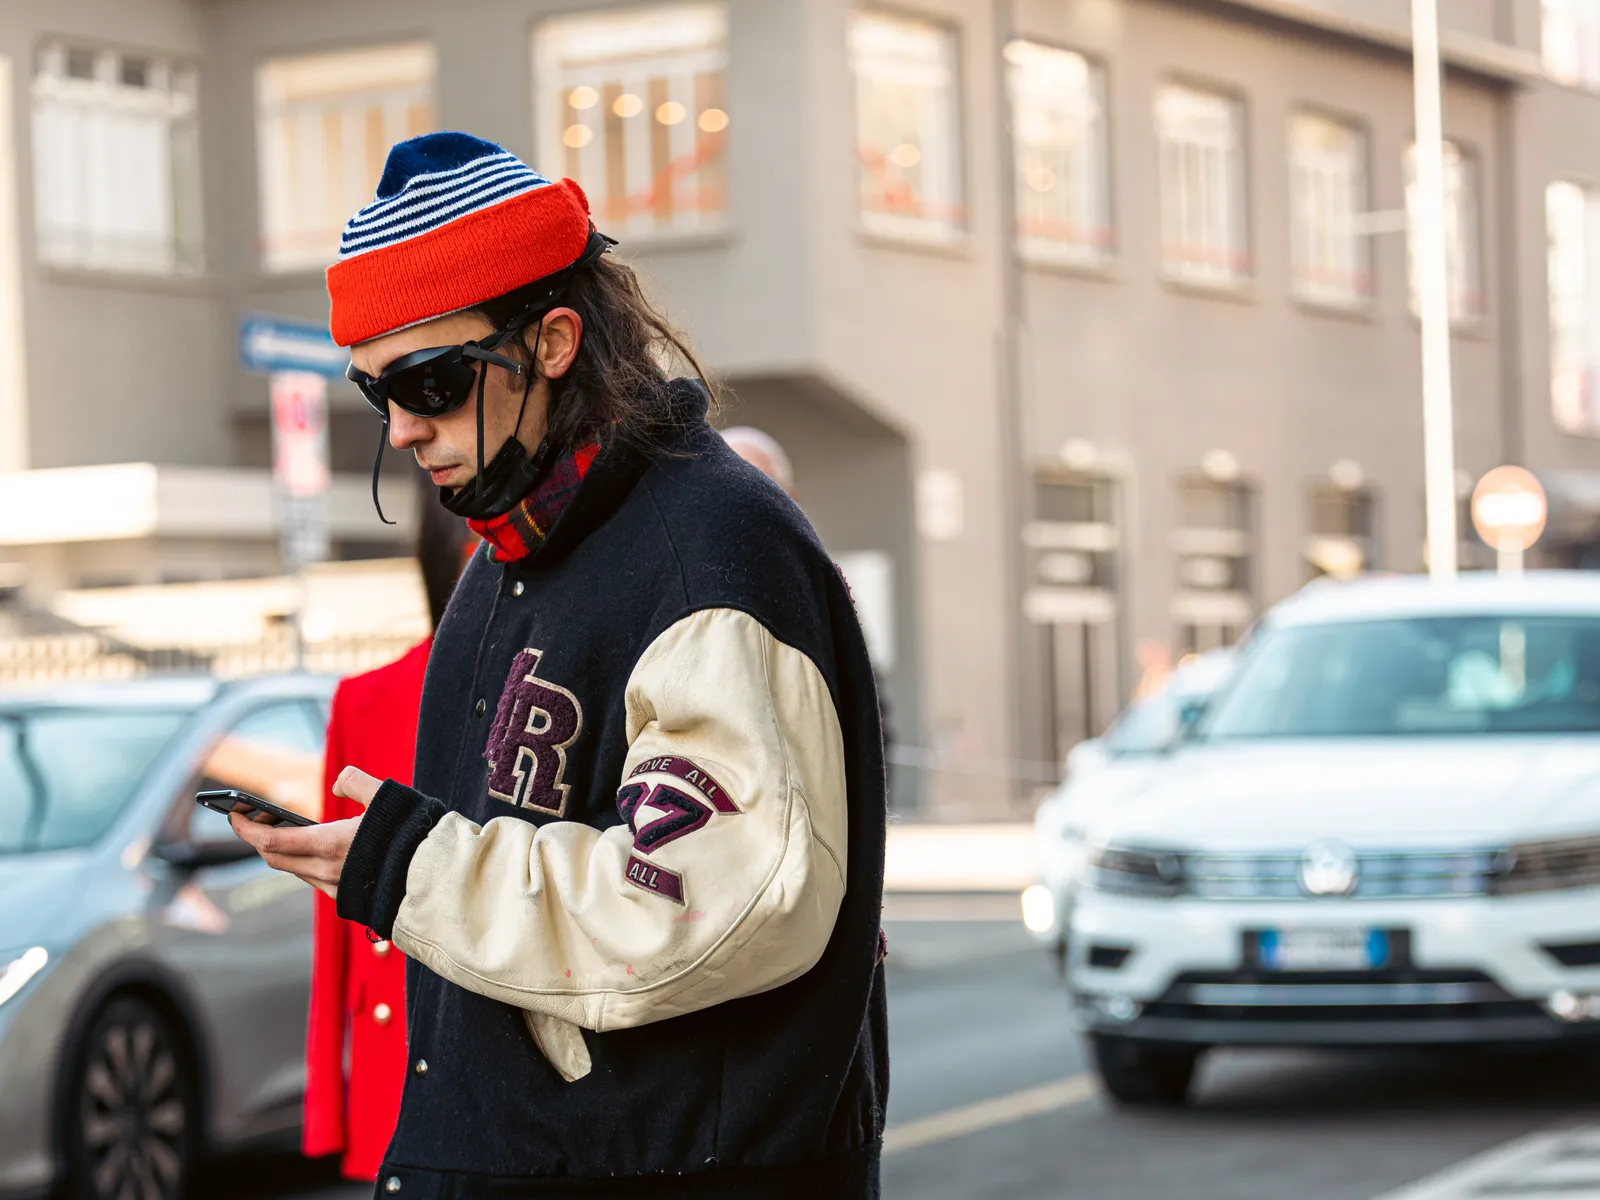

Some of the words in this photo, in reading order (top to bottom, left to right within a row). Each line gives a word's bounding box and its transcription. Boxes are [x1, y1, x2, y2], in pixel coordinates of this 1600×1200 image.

[631, 758, 673, 777] LOVE
[685, 769, 719, 800] ALL
[628, 862, 660, 889] ALL
